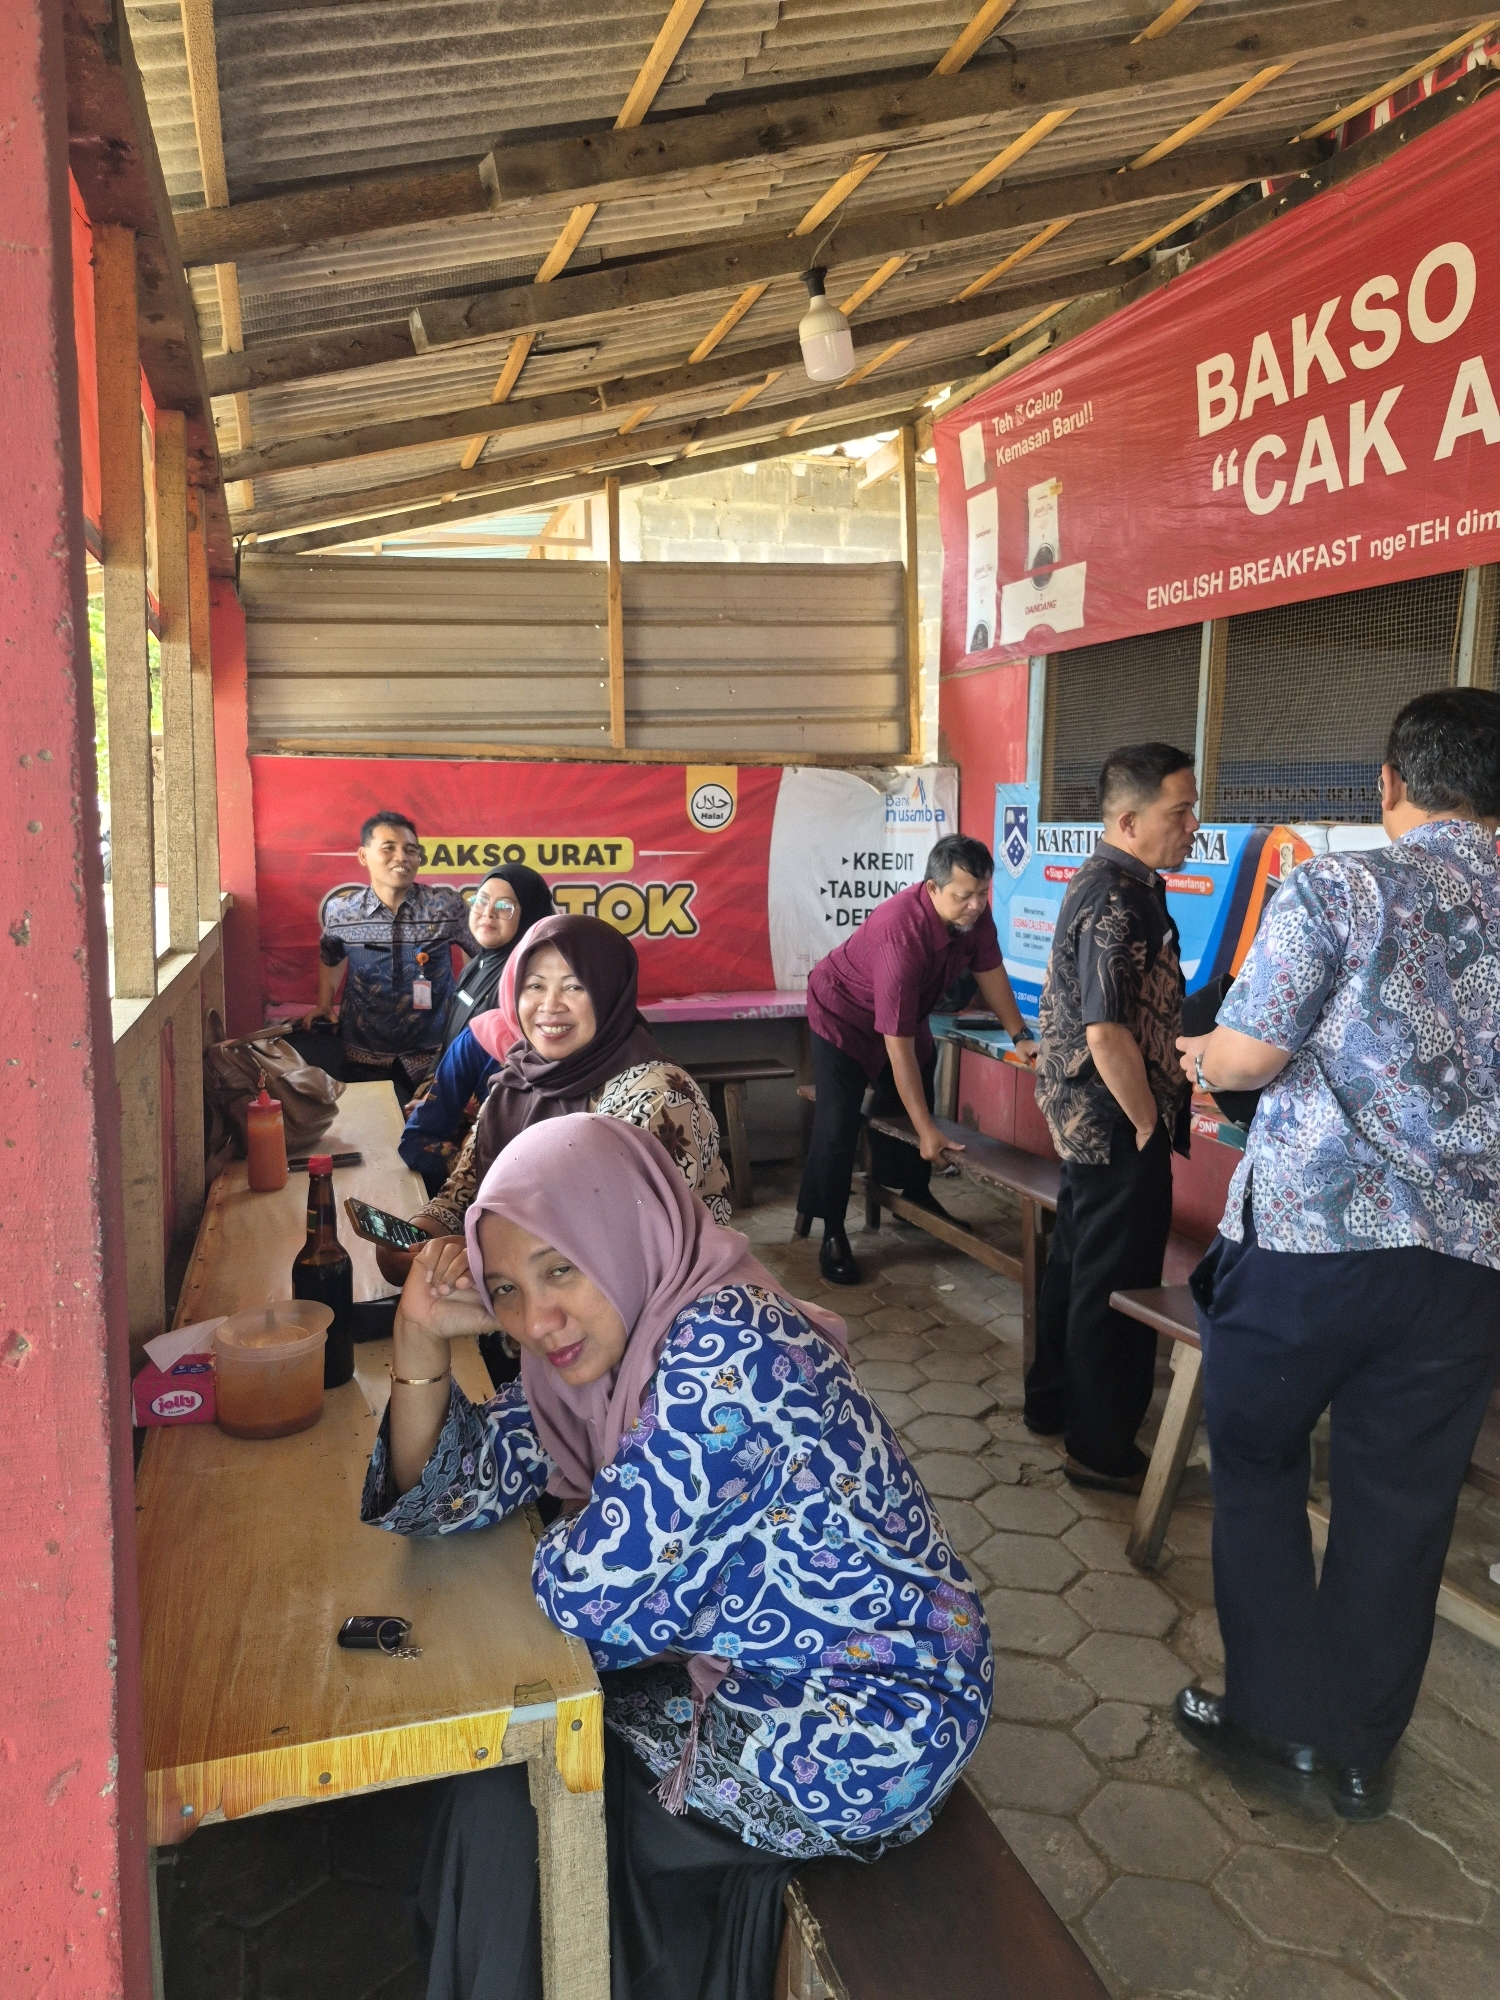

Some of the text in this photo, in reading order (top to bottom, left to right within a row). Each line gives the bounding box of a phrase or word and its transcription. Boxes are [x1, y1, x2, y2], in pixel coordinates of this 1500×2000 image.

[1196, 242, 1476, 437] BAKSO
[992, 388, 1063, 436] Teh Celup
[996, 400, 1094, 467] Kemasan Baru!!
[1212, 384, 1407, 515] “CAK
[1147, 570, 1224, 610] ENGLISH
[1228, 534, 1361, 591] BREAKFAST
[1369, 516, 1450, 560] ngeTEH
[886, 794, 910, 807] Bank
[886, 804, 945, 822] nusamba
[537, 843, 622, 866] URAT
[1186, 831, 1228, 861] NA
[854, 853, 913, 870] KREDIT
[828, 881, 915, 898] TABUN
[158, 1395, 195, 1414] jolly
